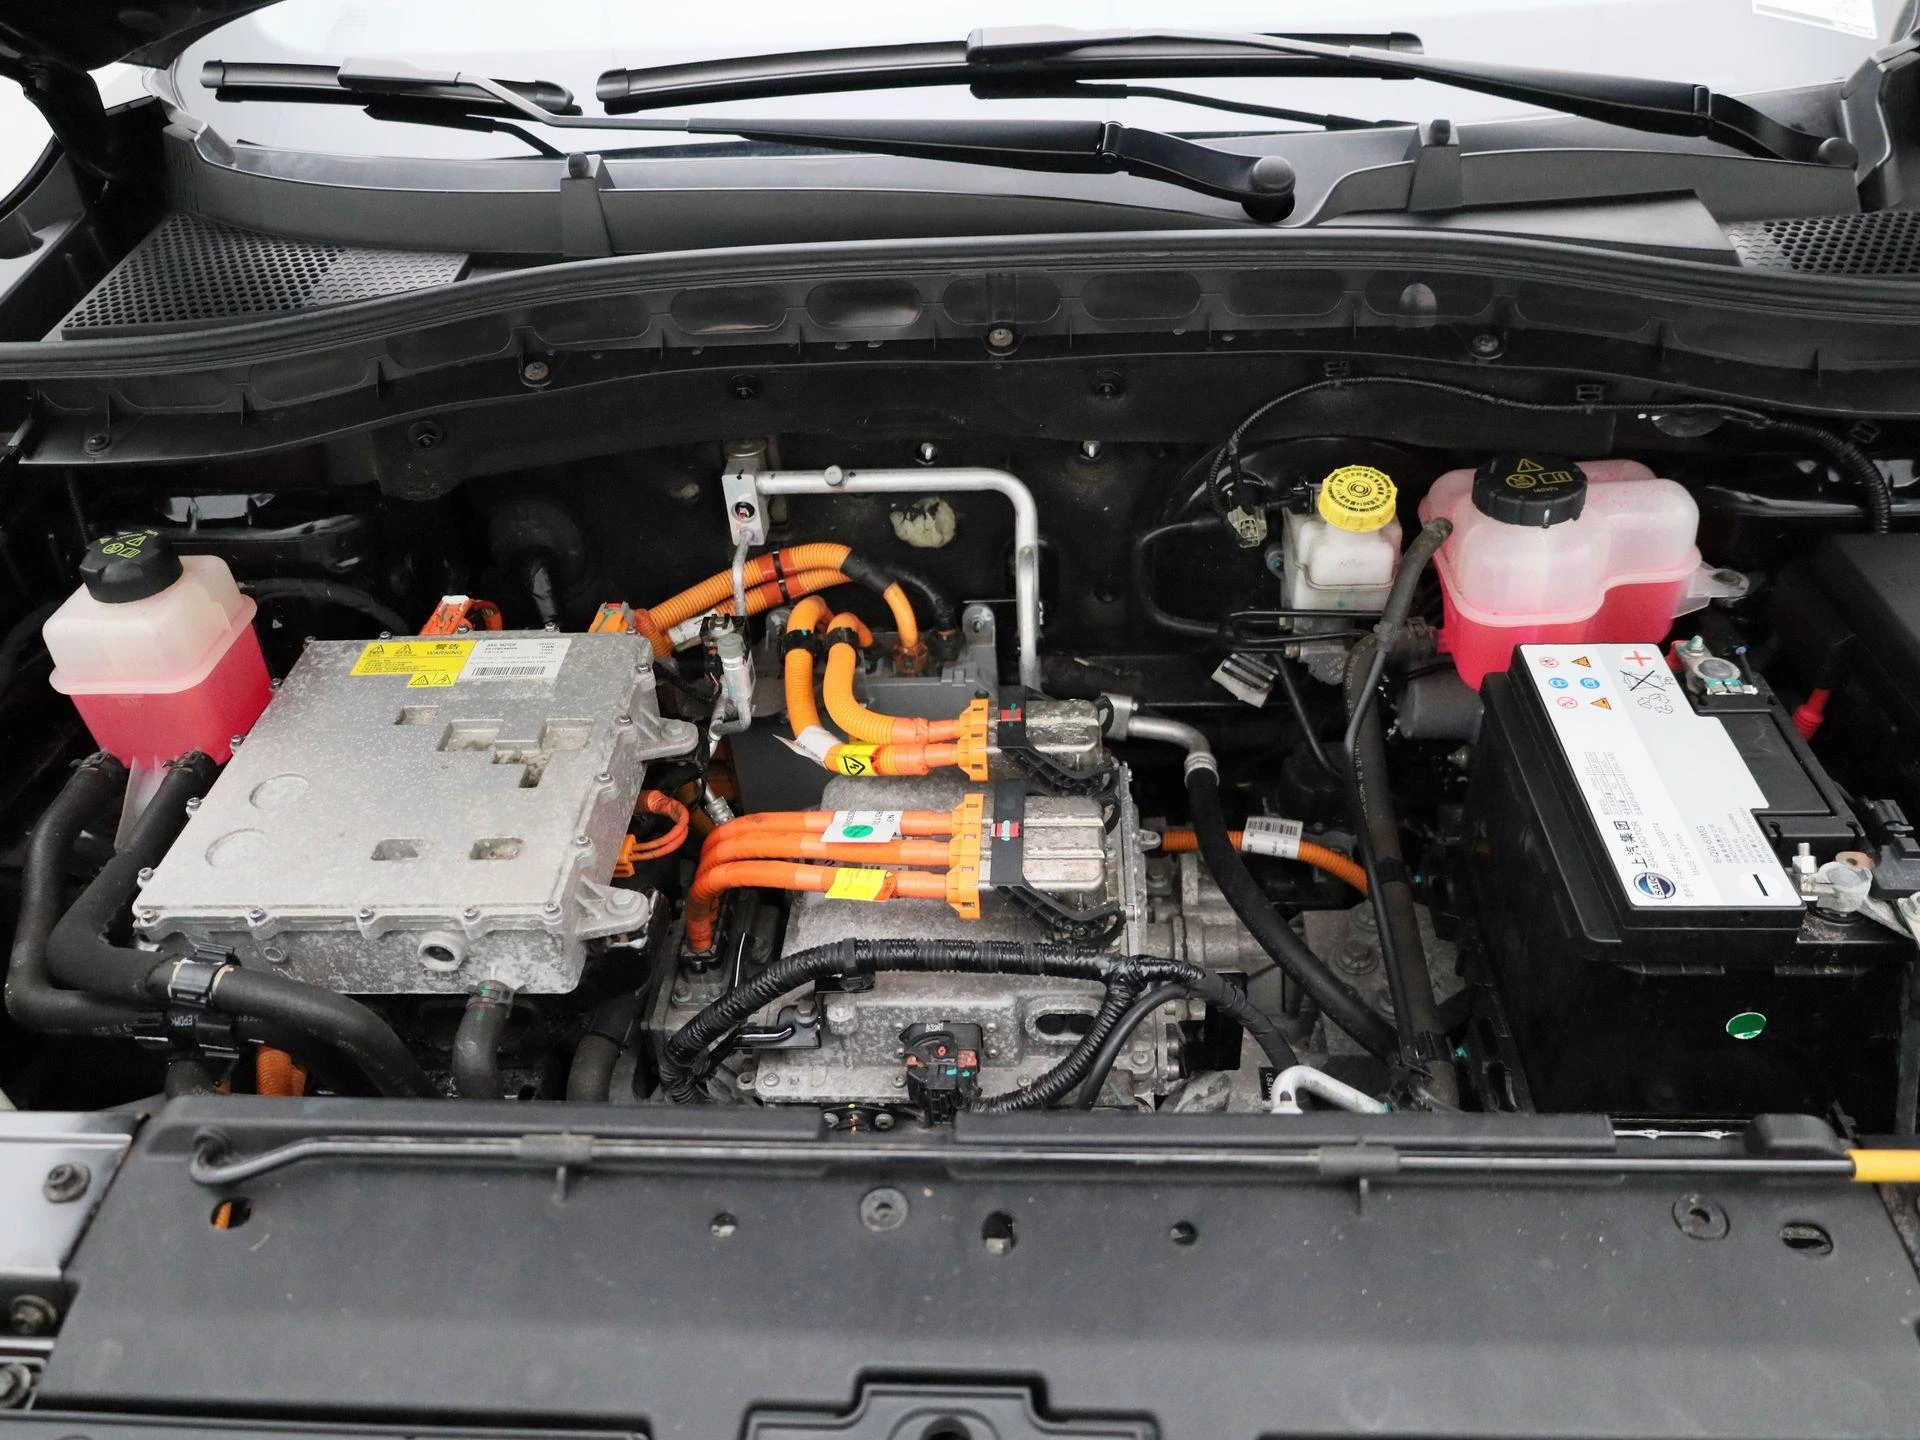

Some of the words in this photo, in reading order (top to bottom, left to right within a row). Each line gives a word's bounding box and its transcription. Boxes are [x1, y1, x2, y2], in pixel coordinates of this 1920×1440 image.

[1614, 820, 1648, 868] 上汽集团
[1630, 820, 1648, 848] MOTOR
[1644, 849, 1659, 868] SAIC
[1648, 875, 1664, 896] SAIC
